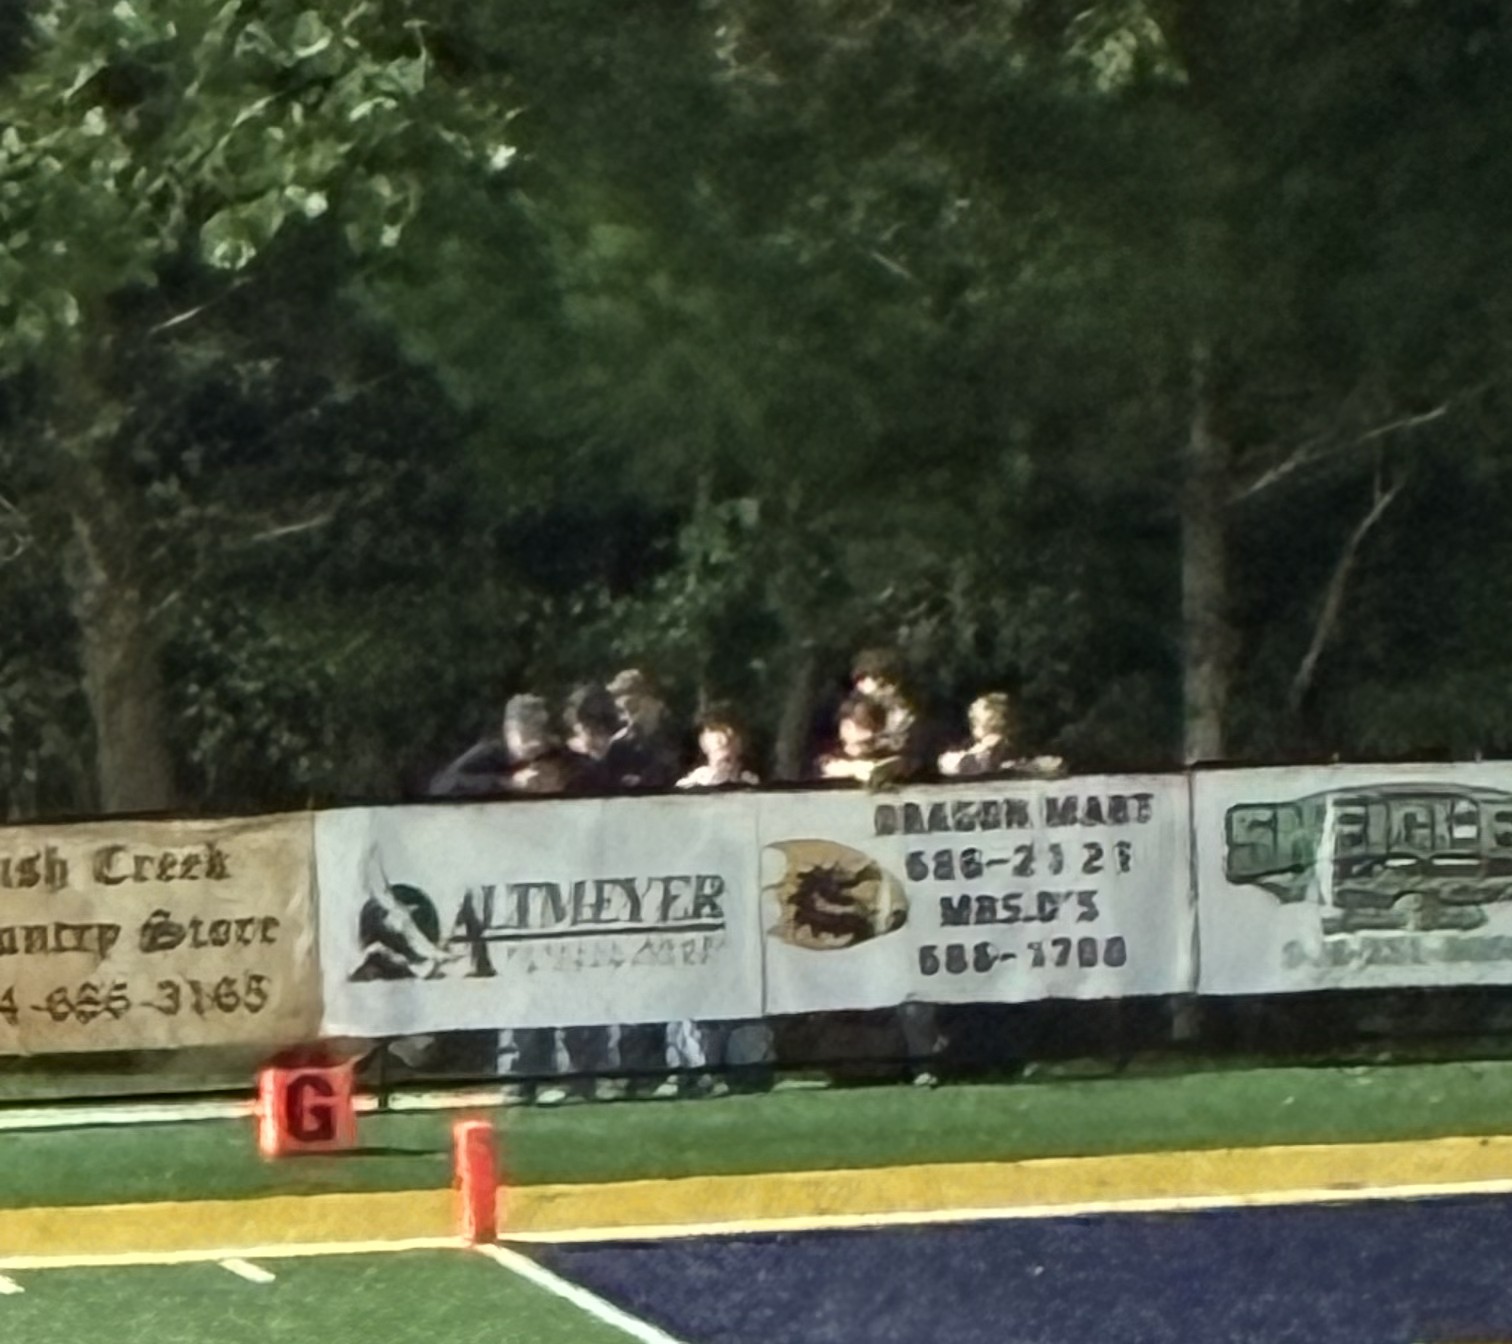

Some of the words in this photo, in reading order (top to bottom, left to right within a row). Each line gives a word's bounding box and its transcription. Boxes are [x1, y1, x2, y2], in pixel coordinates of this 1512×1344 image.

[93, 841, 232, 887] Creek
[446, 873, 726, 979] ALTMEYER
[285, 1073, 336, 1143] G
